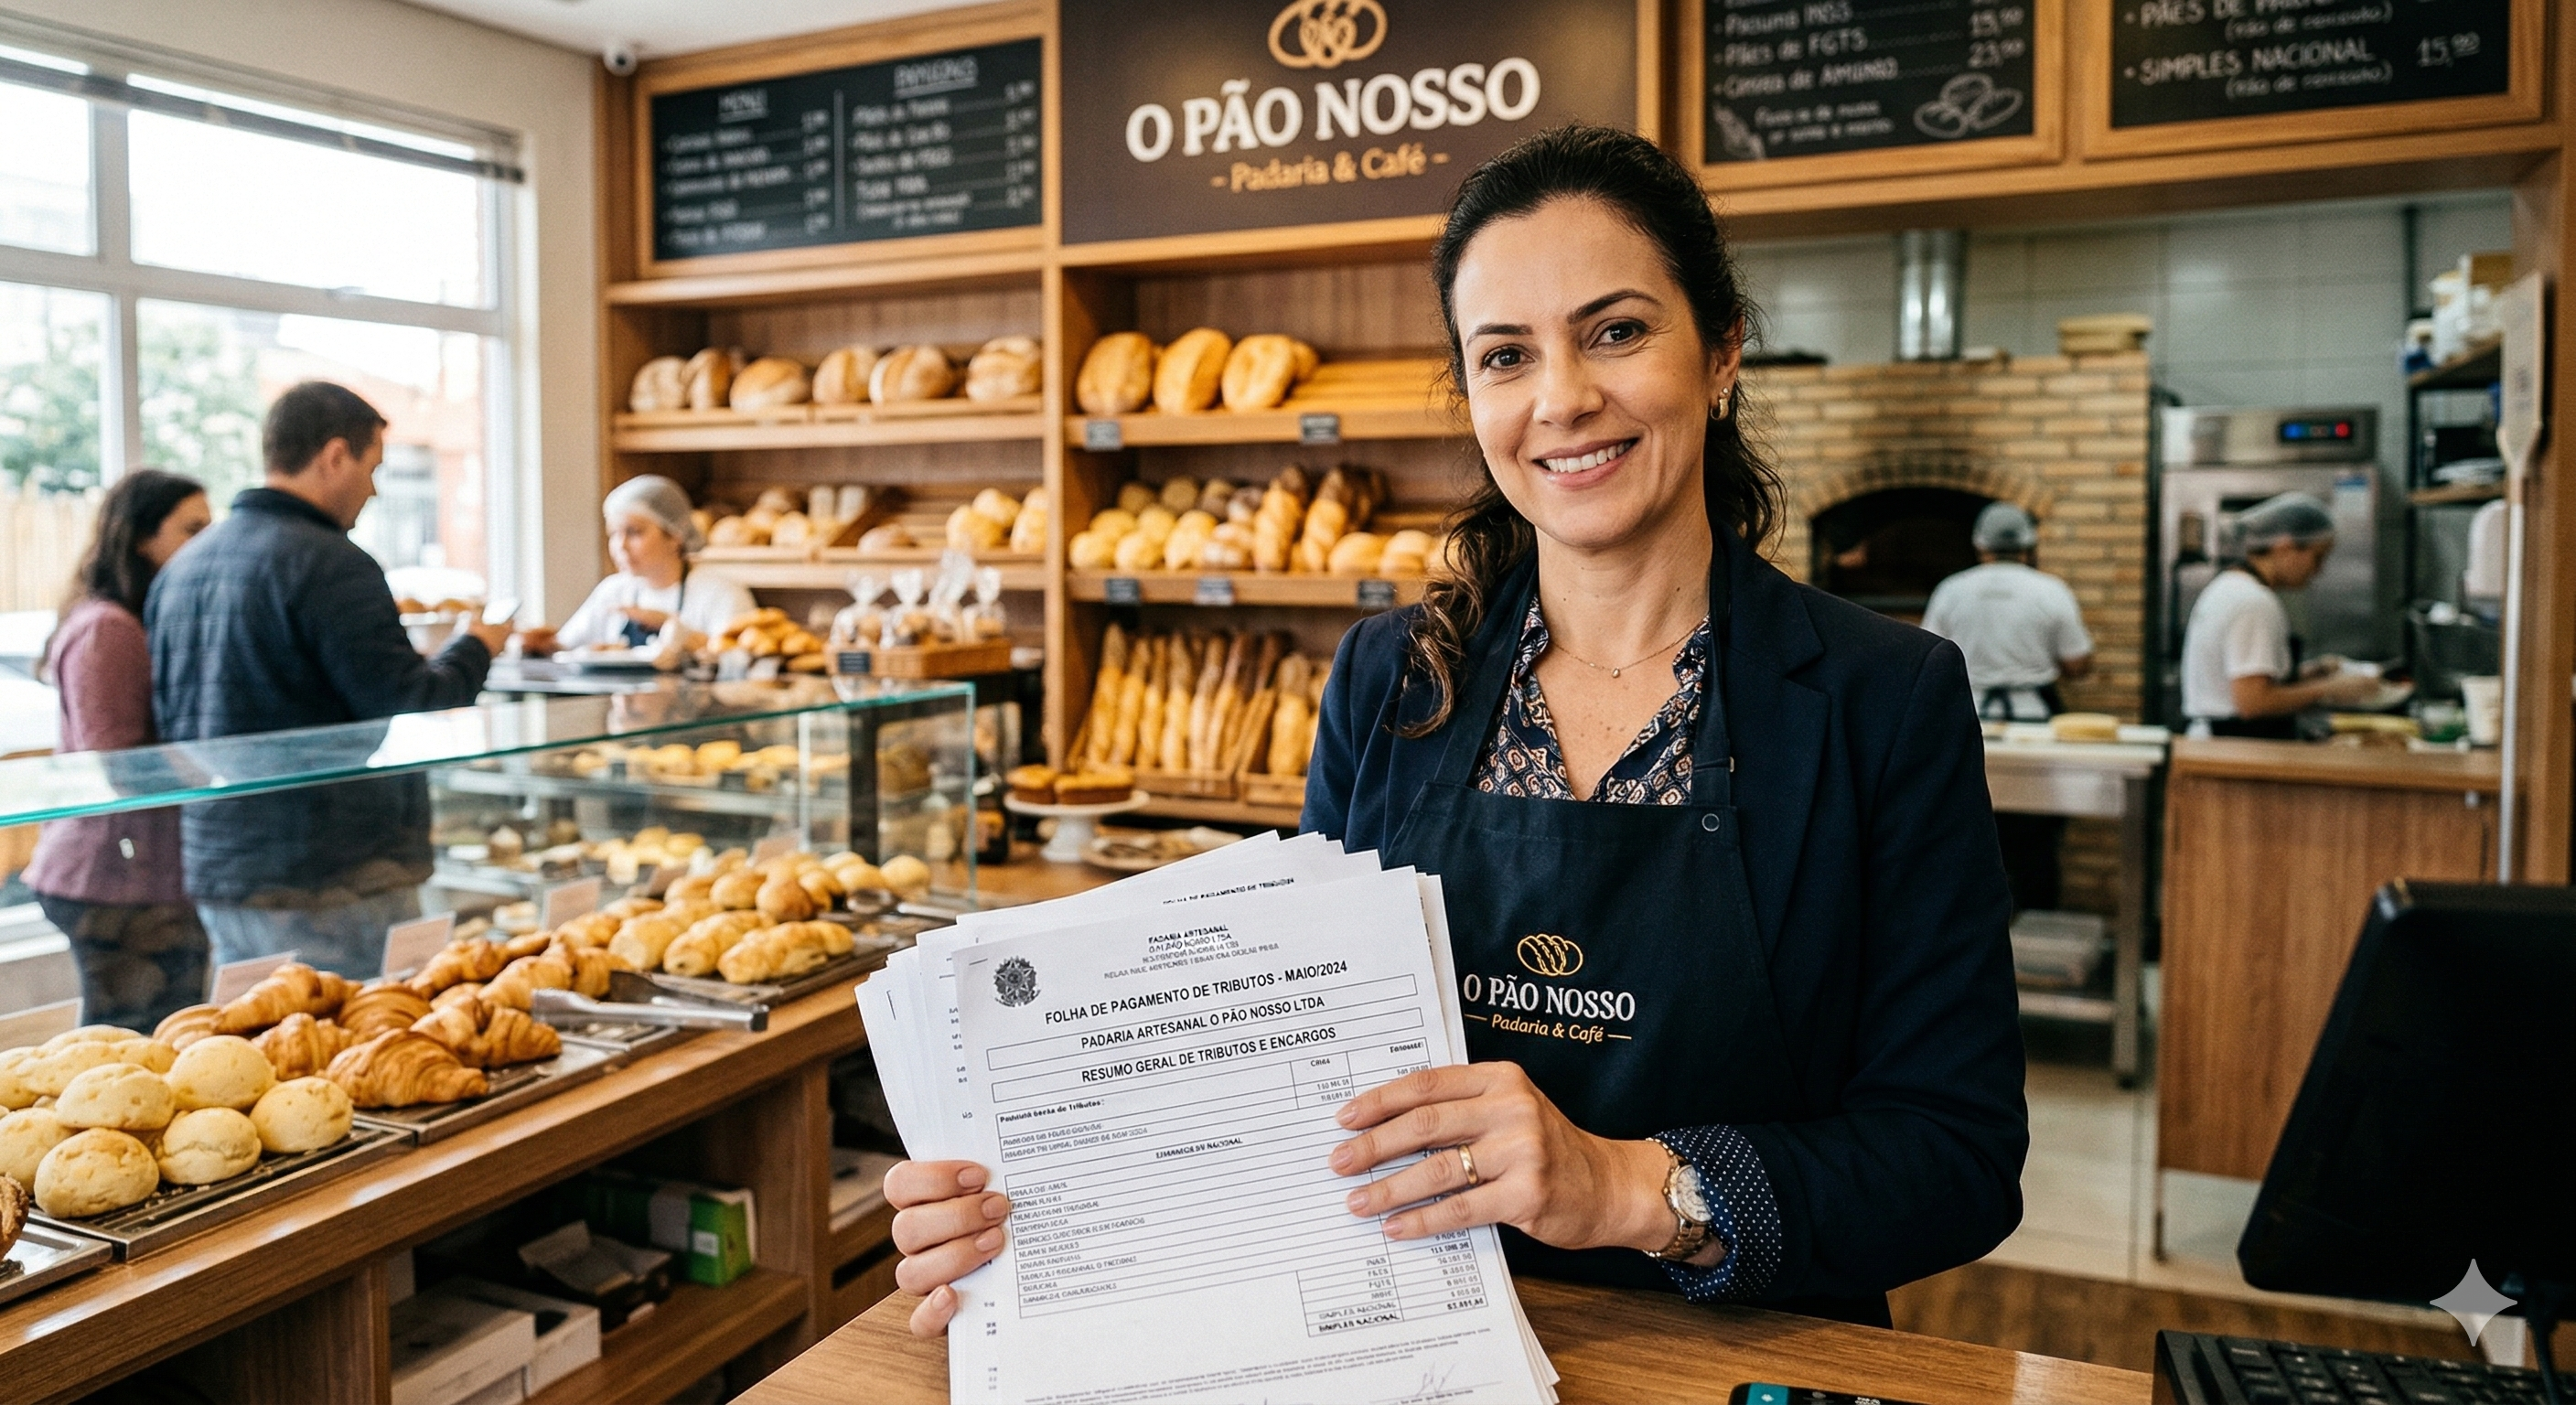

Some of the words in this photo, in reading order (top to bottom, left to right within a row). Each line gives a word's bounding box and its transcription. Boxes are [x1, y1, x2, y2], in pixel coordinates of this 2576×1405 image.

[2140, 50, 2242, 85] SIMPLES
[2251, 37, 2376, 72] NACIONAL
[1125, 103, 1174, 163] O
[1183, 78, 1304, 156] PÃO
[1315, 57, 1541, 142] NOSSO
[1230, 155, 1330, 193] Padaria
[1333, 151, 1358, 184] &
[1361, 142, 1427, 179] Café
[1046, 1007, 1088, 1024] FOLHA
[1091, 1003, 1109, 1017] DE
[1111, 988, 1190, 1013] PAGAMENTO
[1193, 984, 1210, 998] DE
[1213, 973, 1275, 994] TRIBUTOS
[1285, 960, 1347, 982] MAIO/2024
[1464, 973, 1482, 1003] O
[1488, 974, 1540, 1012] PÃO
[1545, 985, 1636, 1022] NOSSO
[1081, 1029, 1134, 1049] PADARIA
[1137, 1016, 1208, 1039] ARTESANAL
[1210, 1014, 1219, 1025] O
[1222, 1008, 1247, 1024] PÃO
[1250, 1001, 1292, 1019] NOSSO
[1293, 996, 1325, 1012] LTDA
[1492, 1014, 1549, 1036] Padaria
[1552, 1023, 1564, 1038] &
[1569, 1024, 1604, 1044] Café
[1082, 1063, 1133, 1083] RESUMO
[1136, 1056, 1176, 1073] GERAL
[1179, 1052, 1196, 1066] DE
[1197, 1041, 1257, 1062] TRIBUTOS
[1260, 1039, 1268, 1051] E
[1271, 1026, 1336, 1049] ENCARGOS
